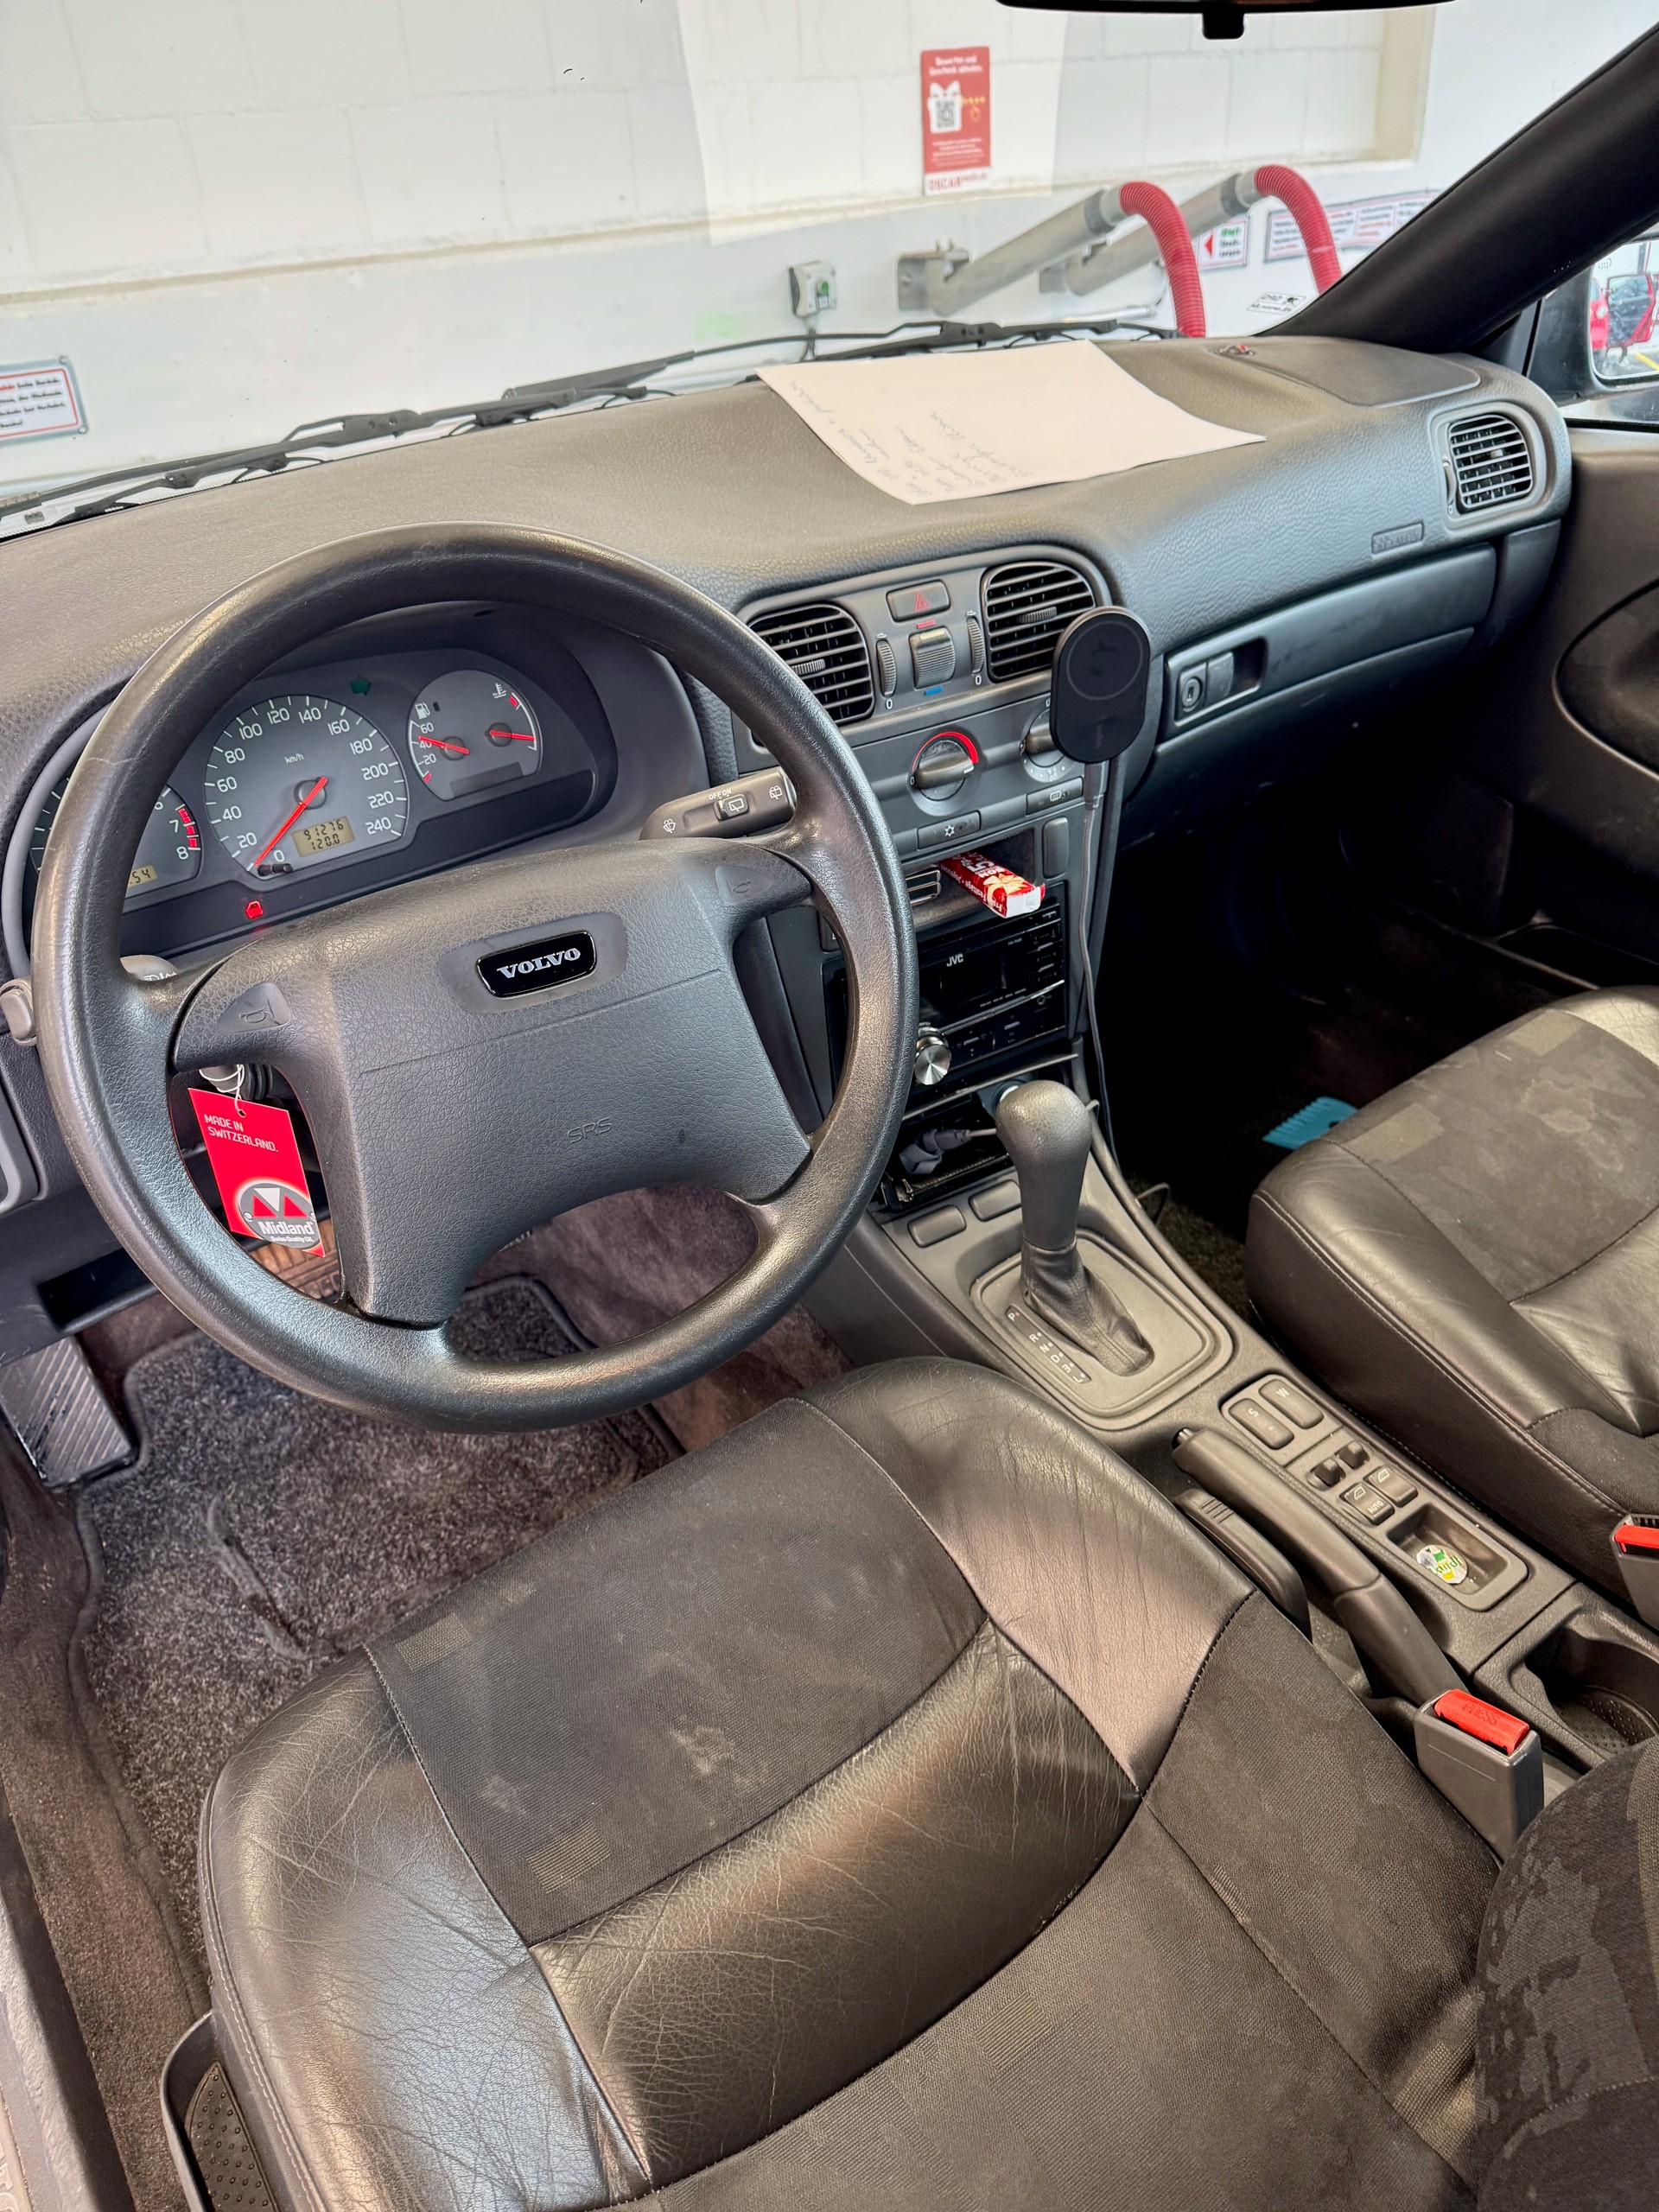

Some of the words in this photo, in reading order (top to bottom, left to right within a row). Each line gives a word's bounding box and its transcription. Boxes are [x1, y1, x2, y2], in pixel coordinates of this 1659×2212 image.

[267, 708, 290, 724] 120
[298, 707, 322, 724] 140
[238, 723, 264, 740] 100
[327, 719, 350, 735] 160
[420, 722, 435, 734] 60
[349, 738, 373, 755] 180
[224, 748, 245, 764] 80
[284, 753, 304, 764] km/h
[423, 753, 437, 765] 20
[361, 762, 389, 781] 200
[217, 776, 238, 793] 60
[368, 791, 394, 809] 220
[709, 792, 721, 801] OFF
[223, 805, 242, 821] 40
[169, 819, 179, 833] 7
[365, 817, 391, 835] 240
[237, 832, 257, 849] 20
[311, 833, 340, 850] 120.0
[176, 846, 189, 860] 8
[274, 849, 286, 862] 0
[496, 947, 582, 979] VOLVO
[946, 952, 964, 967] JVC
[203, 1113, 233, 1129] MADE
[232, 1121, 245, 1133] IN
[567, 1116, 612, 1144] SRS
[207, 1126, 279, 1153] SWITZERLAND.
[257, 1221, 315, 1235] Midland
[1007, 1313, 1015, 1321] P
[1028, 1333, 1039, 1344] R
[1039, 1344, 1051, 1353] N
[1050, 1354, 1061, 1363] D
[1061, 1363, 1071, 1373] 3
[1248, 1408, 1259, 1417] S
[1367, 1500, 1384, 1514] AUTO
